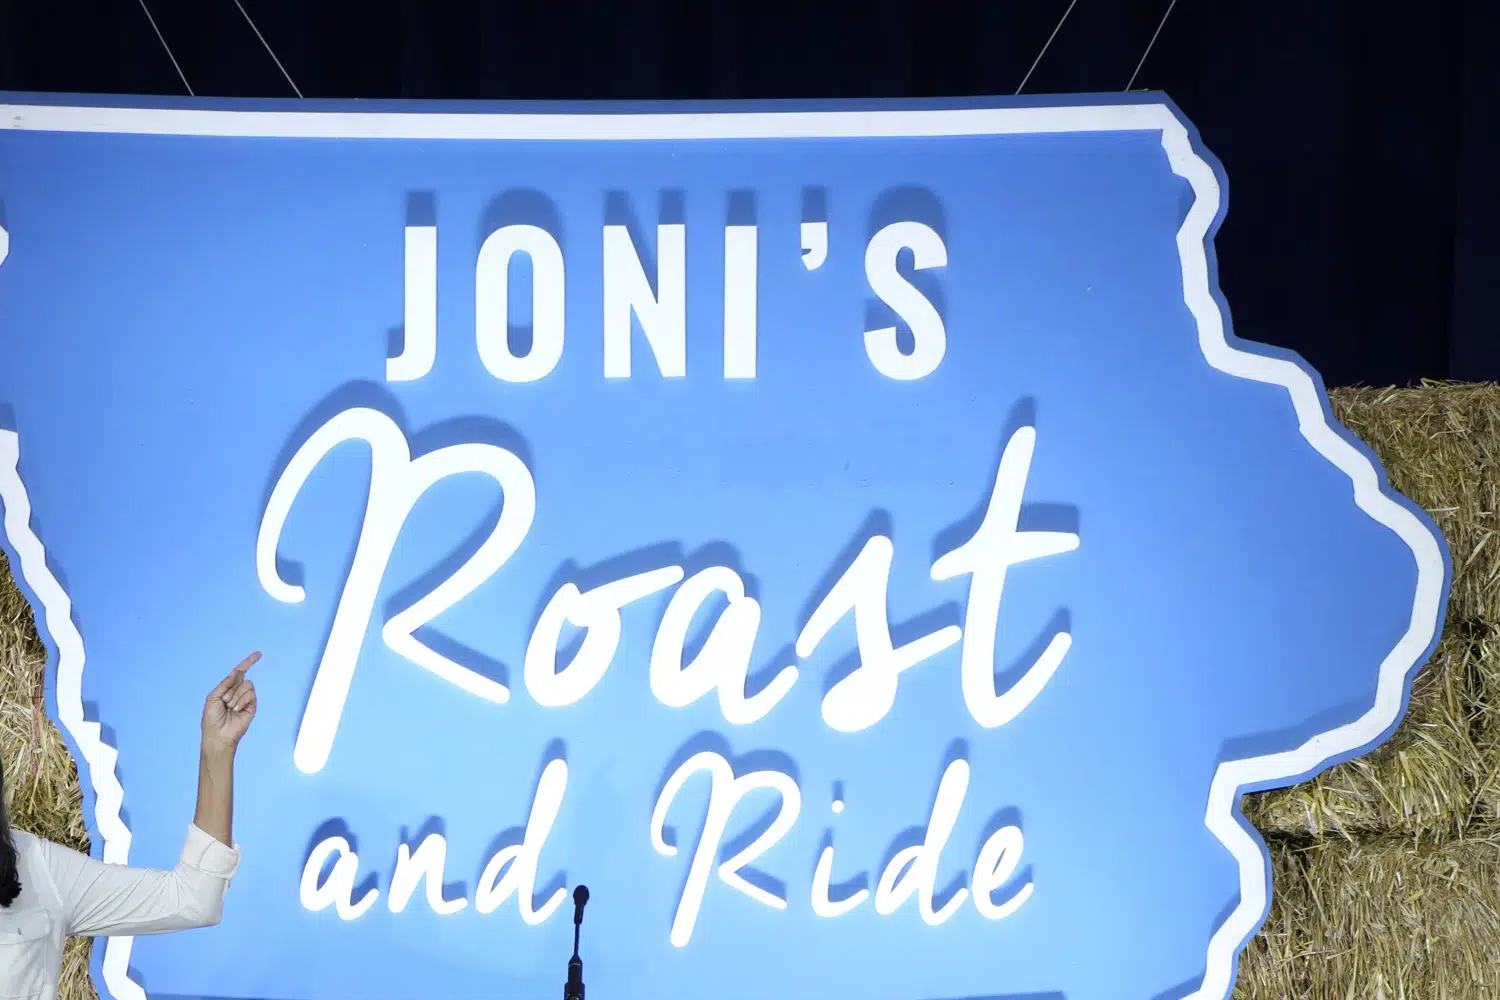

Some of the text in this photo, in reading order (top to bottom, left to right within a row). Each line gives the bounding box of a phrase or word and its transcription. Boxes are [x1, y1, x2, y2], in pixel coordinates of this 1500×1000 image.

[386, 221, 948, 383] JONI'S
[256, 407, 1080, 774] Roast
[300, 752, 1034, 948] and Ride
